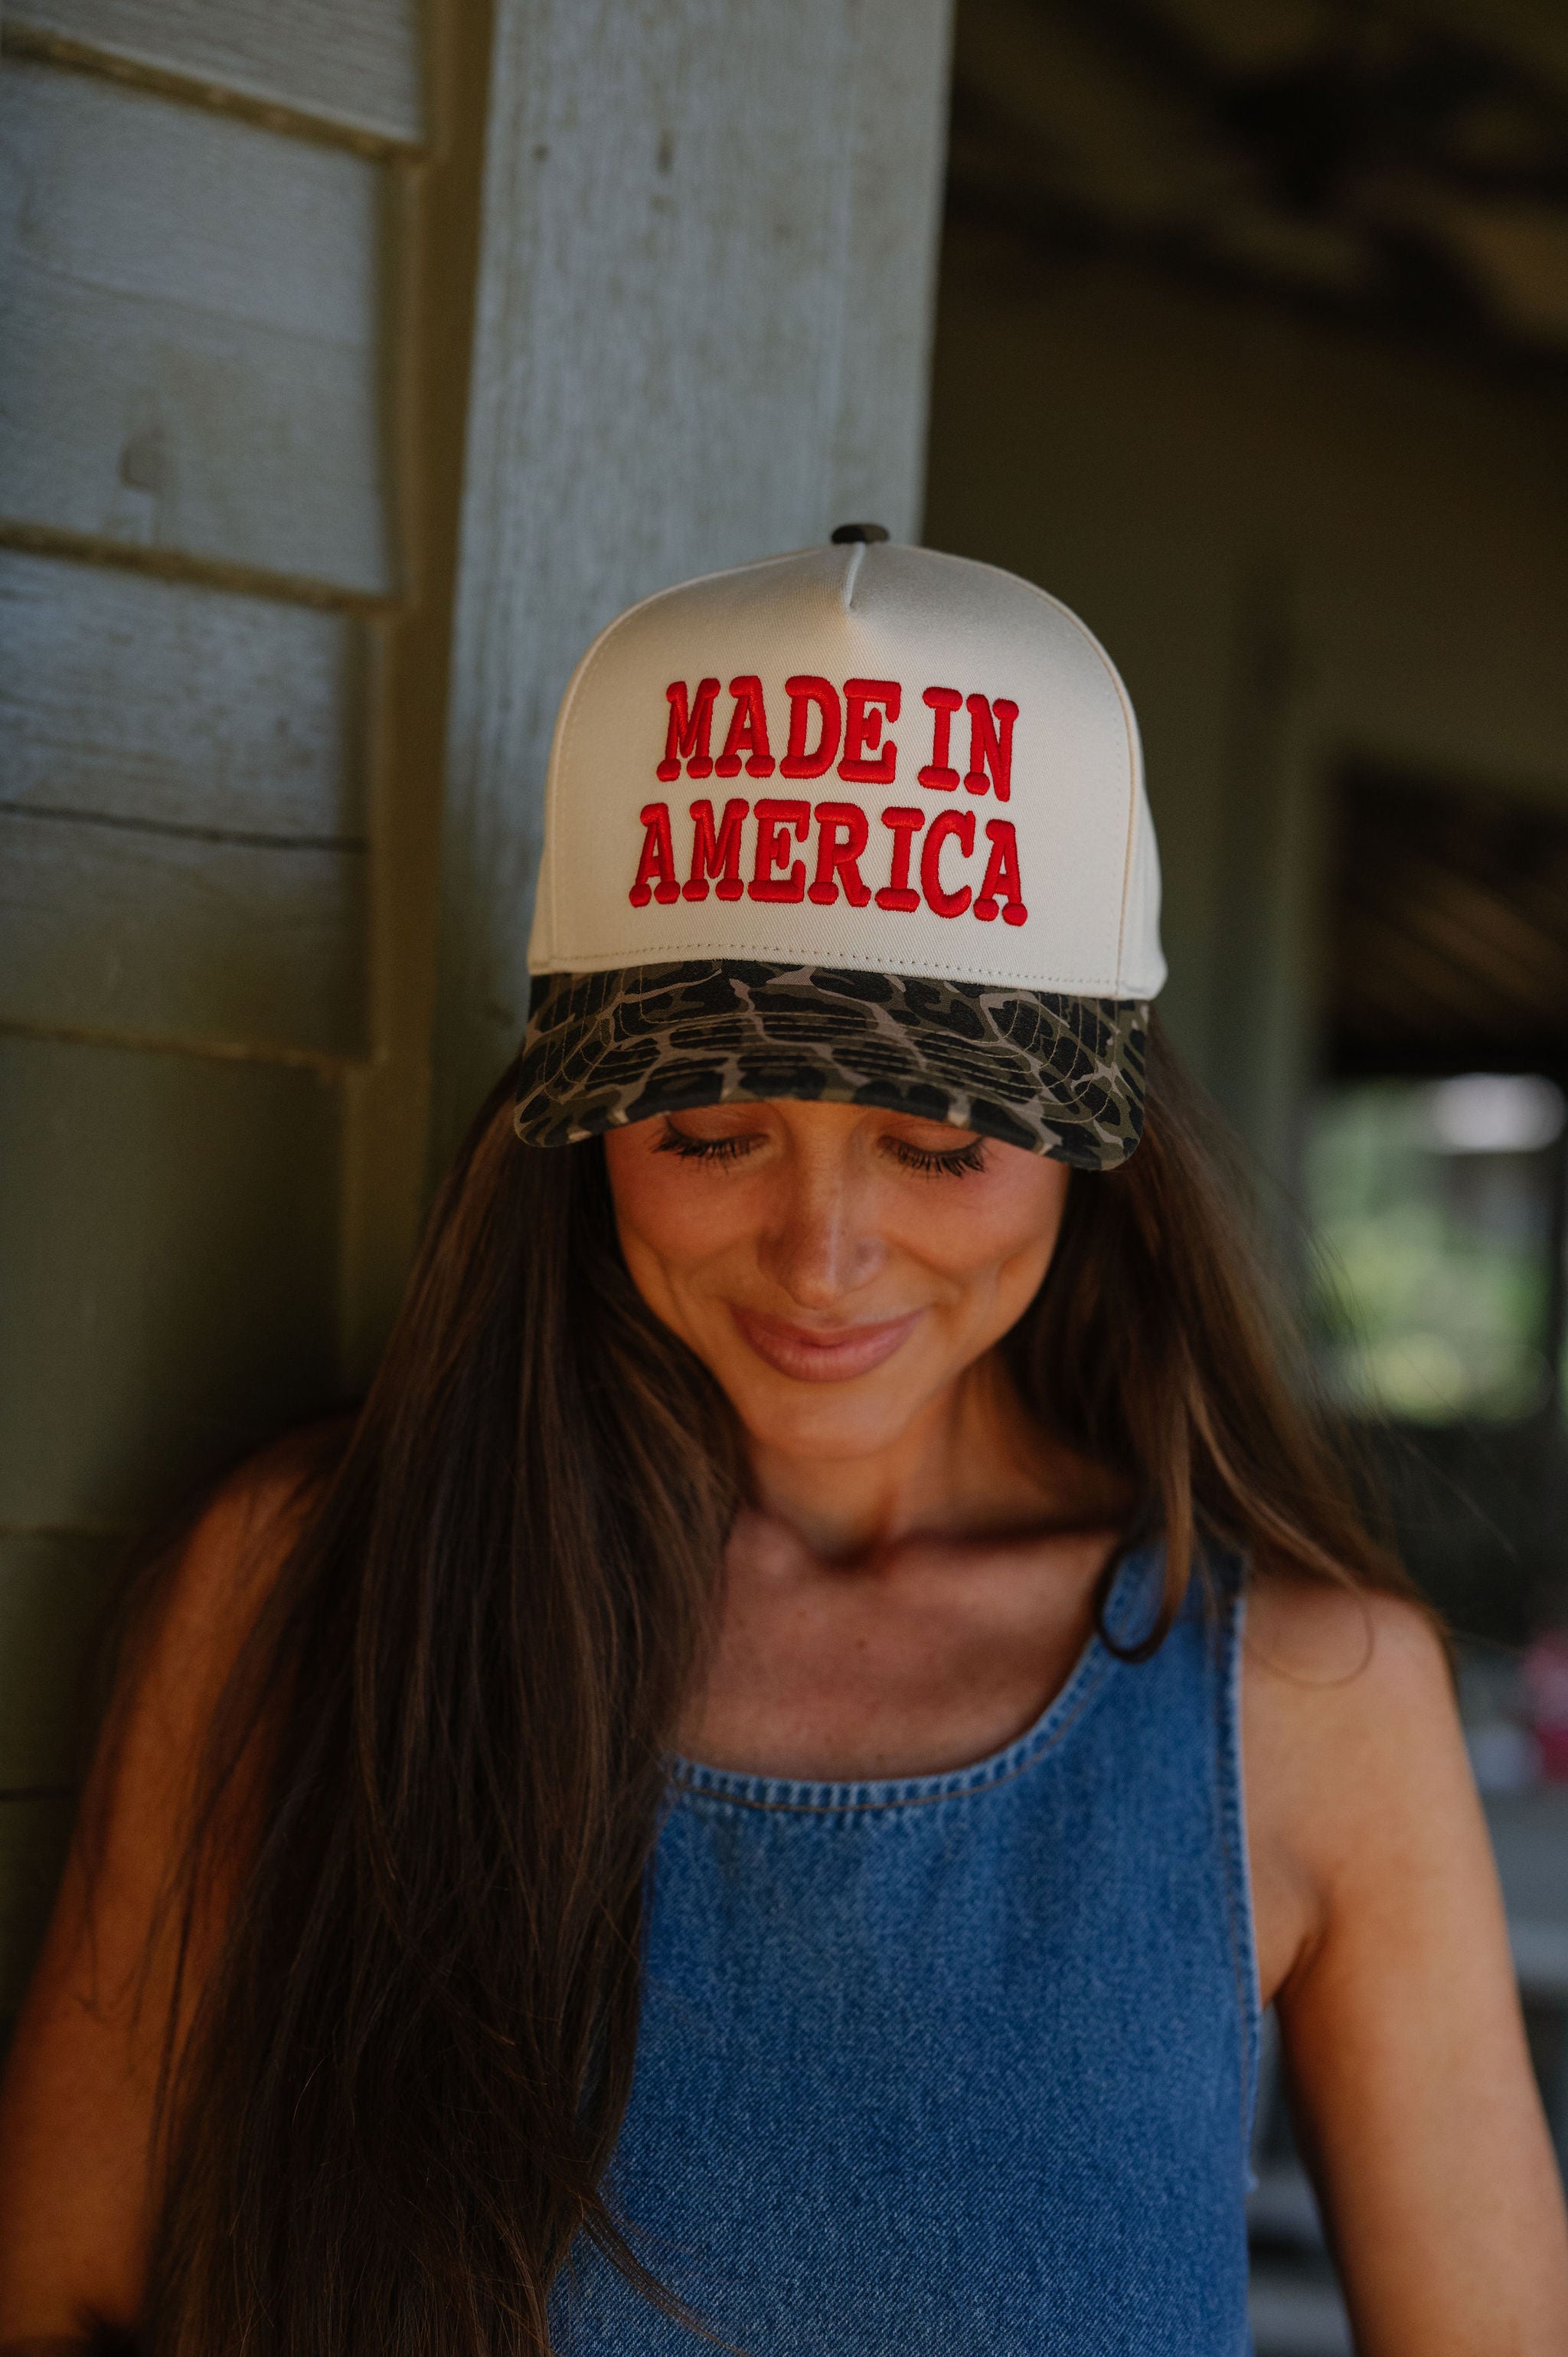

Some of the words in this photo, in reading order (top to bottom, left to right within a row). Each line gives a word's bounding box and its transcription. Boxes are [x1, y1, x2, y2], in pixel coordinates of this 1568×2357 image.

[656, 675, 901, 784] MADE
[917, 687, 1019, 802] IN
[629, 799, 1027, 927] AMERICA
